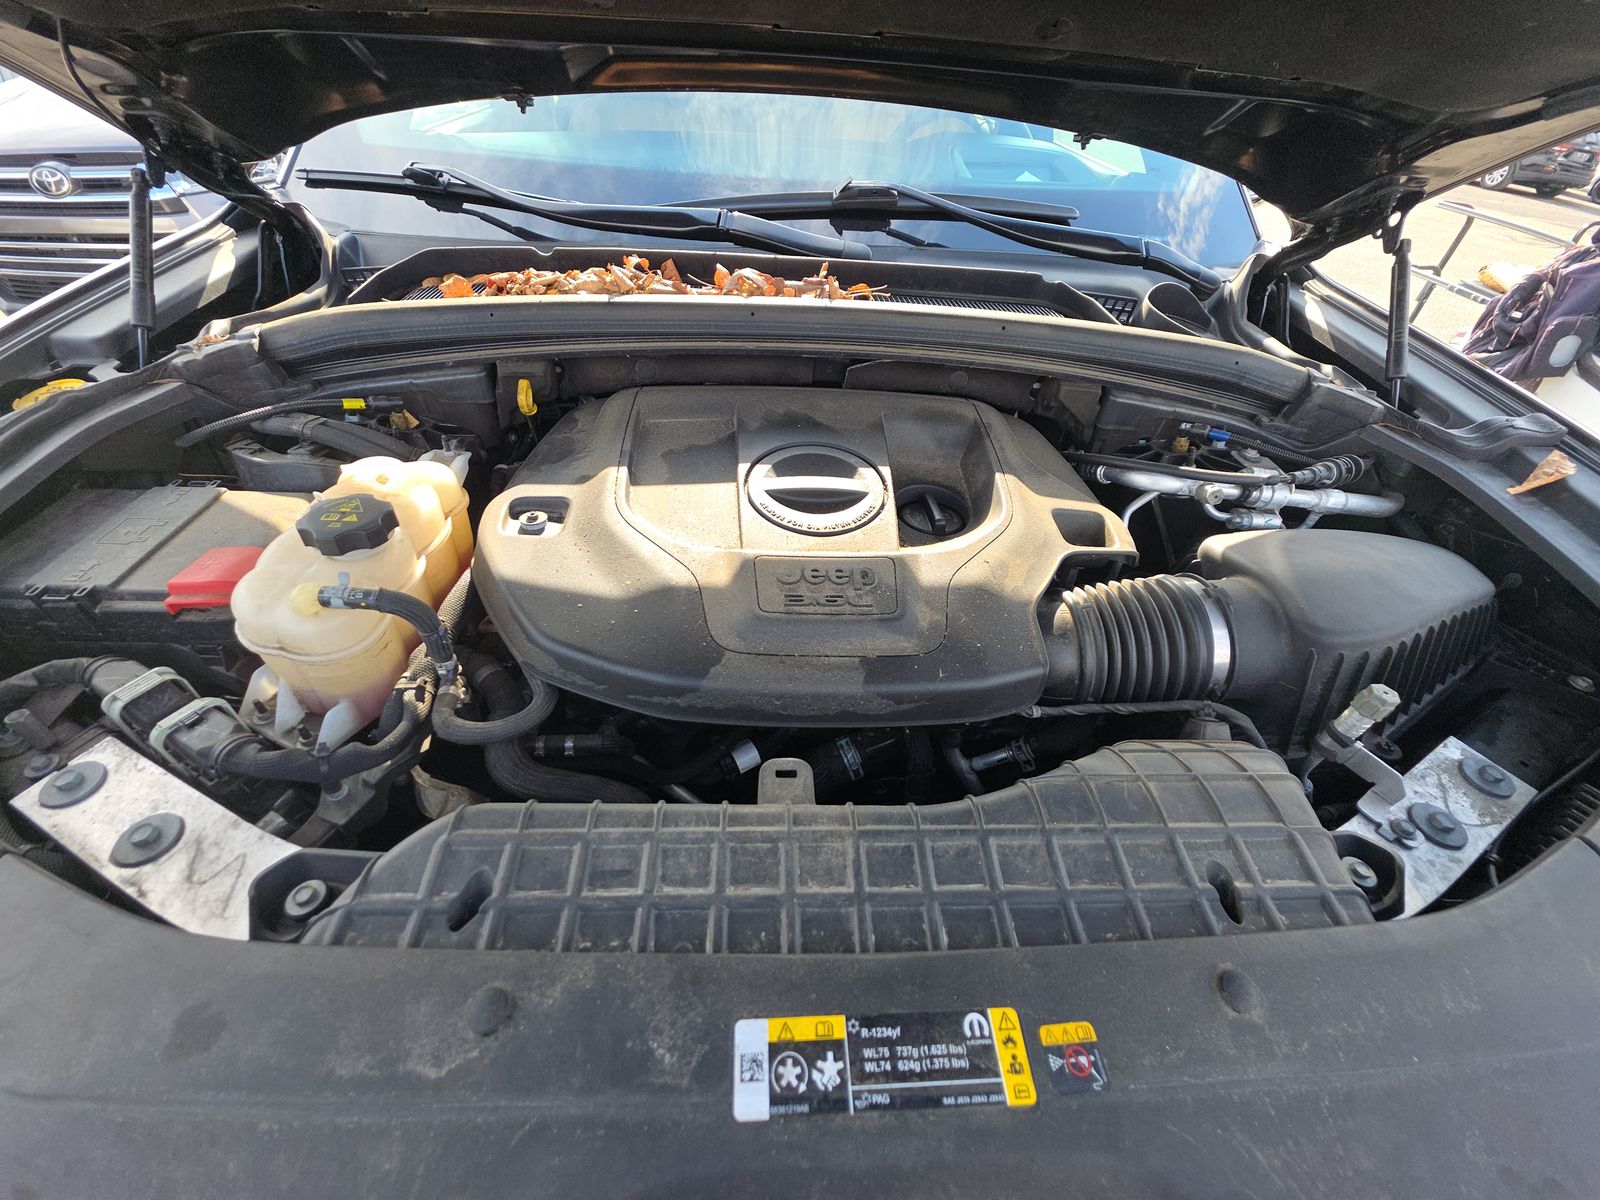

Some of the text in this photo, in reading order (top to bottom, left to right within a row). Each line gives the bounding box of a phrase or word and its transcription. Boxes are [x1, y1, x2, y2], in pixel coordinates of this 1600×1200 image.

[776, 564, 878, 592] Jeep
[783, 593, 874, 608] 3.6L
[861, 1025, 901, 1040] R-1234yf
[863, 1047, 890, 1059] WL75
[895, 1045, 919, 1060] 737g
[864, 1060, 892, 1073] WL74
[897, 1059, 921, 1073] 624g
[872, 1092, 891, 1105] PAG
